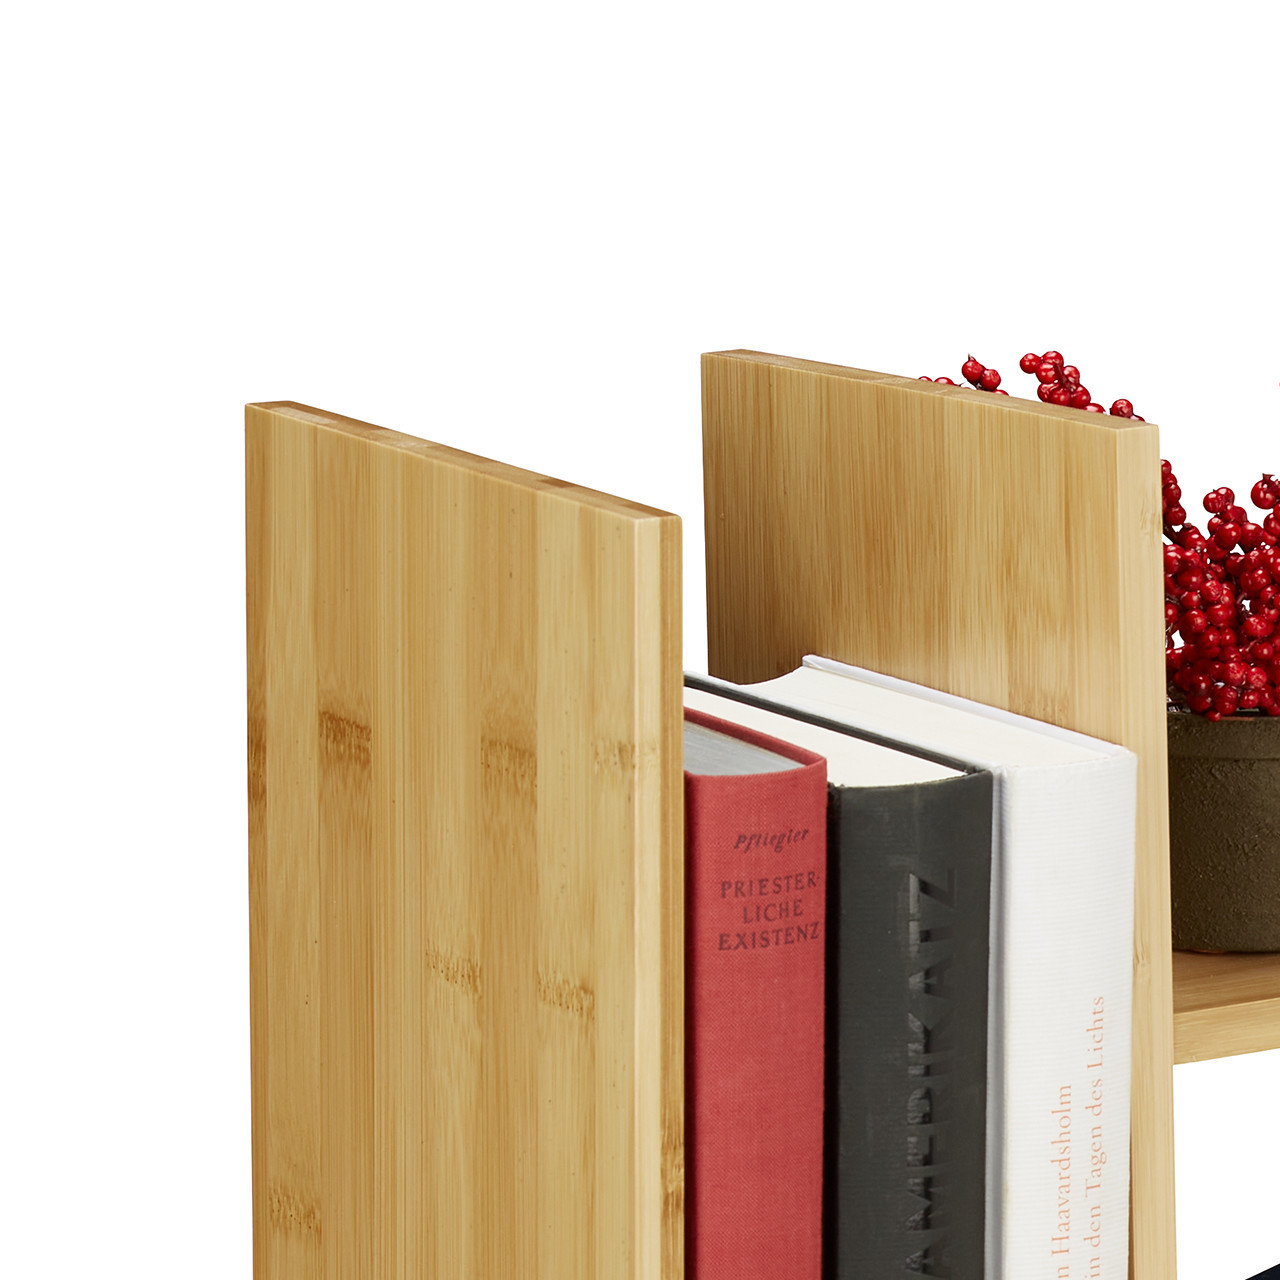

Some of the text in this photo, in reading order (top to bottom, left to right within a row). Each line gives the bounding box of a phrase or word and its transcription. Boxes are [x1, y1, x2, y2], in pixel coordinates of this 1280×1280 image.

[743, 899, 803, 924] LICHE
[718, 921, 820, 950] EXISTENZ
[1086, 995, 1104, 1070] Lichts
[1085, 1078, 1103, 1117] des
[1050, 1083, 1072, 1256] Haavardsholm
[1085, 1124, 1108, 1198] Tagen
[1083, 1205, 1102, 1248] den
[1084, 1256, 1101, 1278] in
